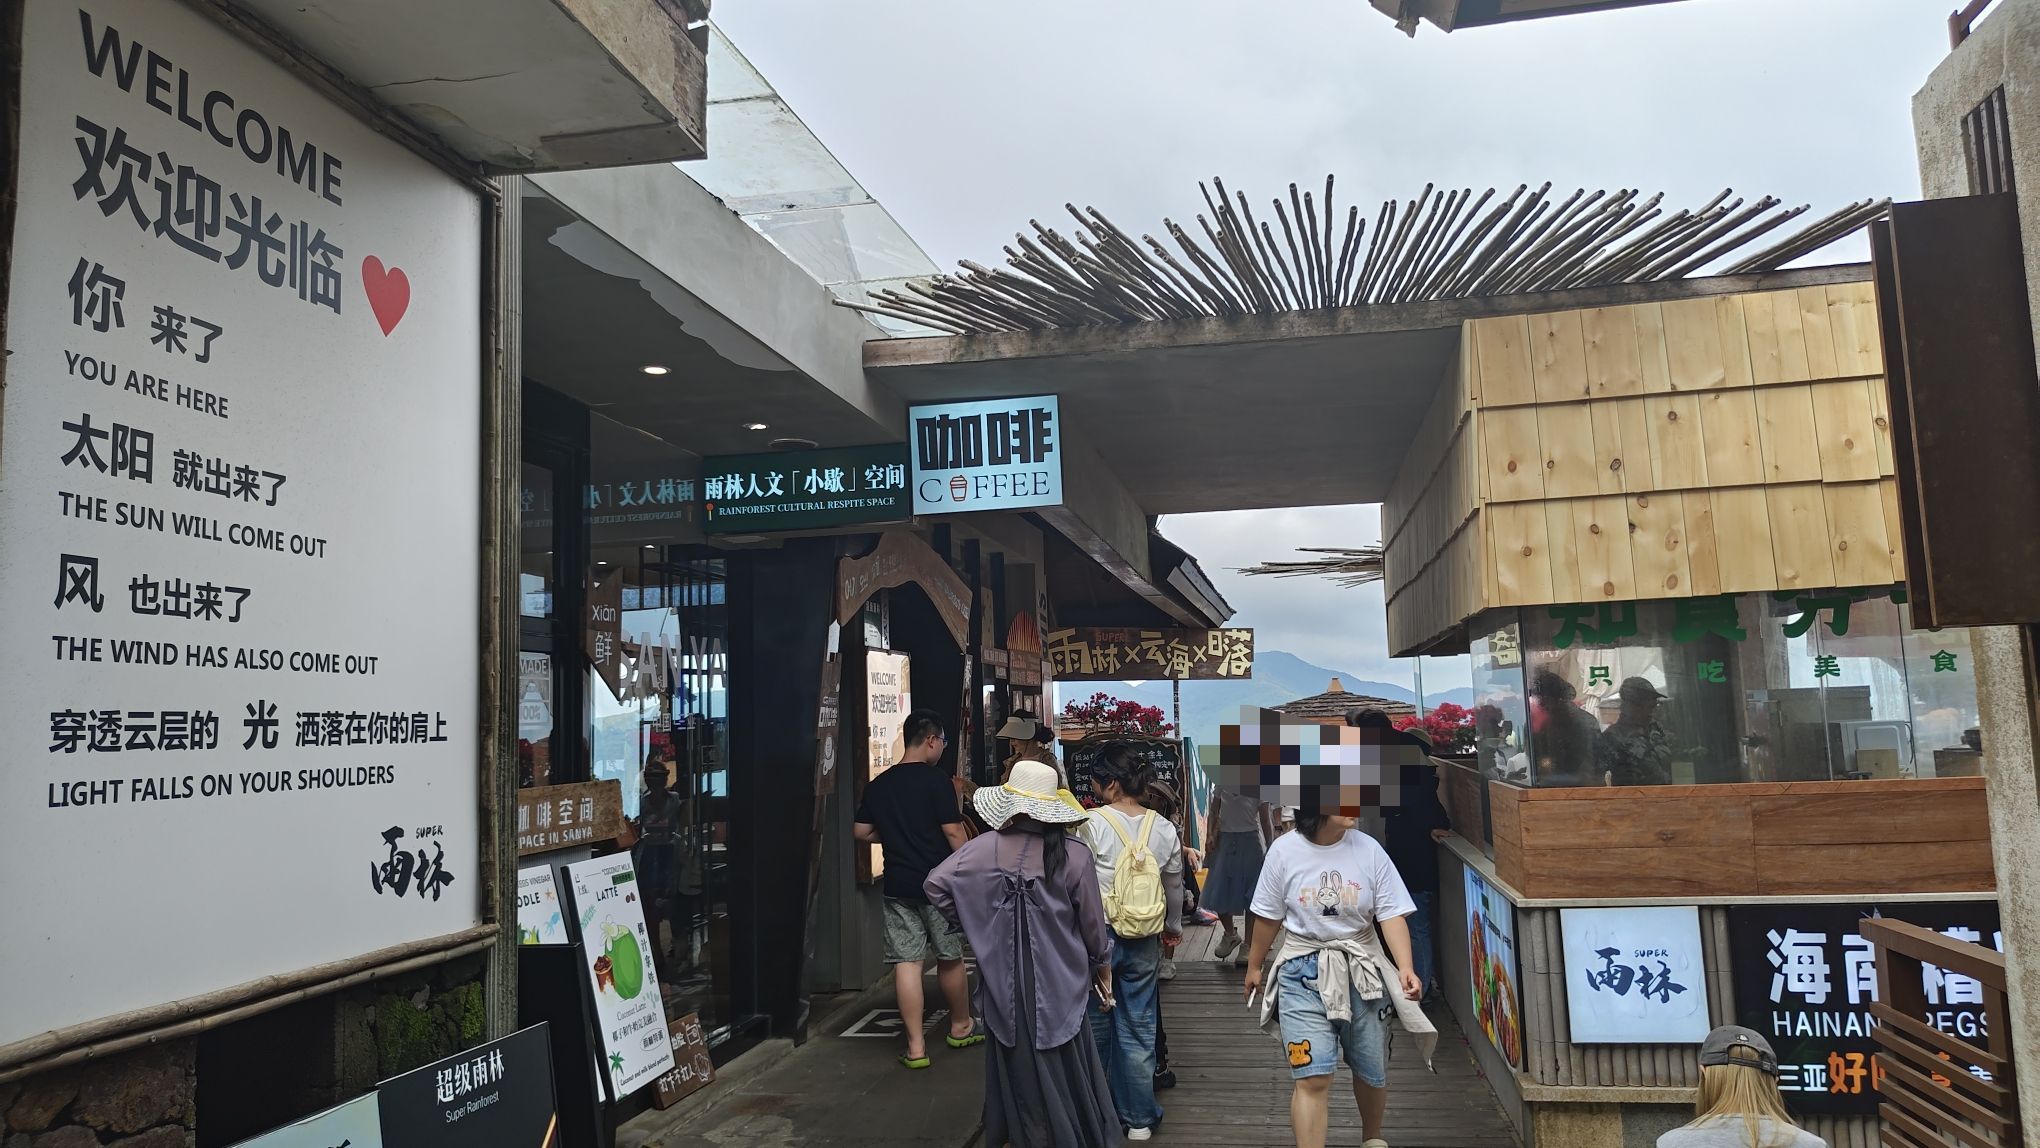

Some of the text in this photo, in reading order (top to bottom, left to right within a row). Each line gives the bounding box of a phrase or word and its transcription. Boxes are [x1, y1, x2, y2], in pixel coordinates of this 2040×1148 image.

[78, 8, 343, 207] WELCOME
[72, 115, 344, 315] 欢迎光临
[68, 257, 223, 364] 你 来了
[65, 350, 229, 419] YOU ARE HERE
[61, 413, 288, 507] 太阳 就出来了
[915, 408, 1054, 470] 咖啡
[59, 491, 327, 558] THE SUN WILL COME OUT
[718, 496, 896, 516] RAINFOREST CULTURAL RESPITE SPACE
[54, 554, 251, 623] 风 也出来了
[53, 636, 378, 675] THE WIND HAS ALSO COME OUT
[594, 632, 614, 667] 鲜
[871, 671, 897, 687] WELCOME
[48, 700, 448, 753] 穿透云层的 光 洒落在你的肩上
[48, 765, 395, 808] LIGHT FALLS ON YOUR SHOULDERS
[415, 825, 444, 839] SUPER
[549, 832, 559, 845] IN
[563, 827, 594, 842] SANYA
[371, 826, 455, 902] 雨林
[596, 885, 619, 902] LATTE
[1586, 947, 1688, 1003] 雨林
[1634, 949, 1669, 958] SUPER
[436, 1048, 505, 1106] 超级雨林
[446, 1090, 500, 1124] Super Rainforest
